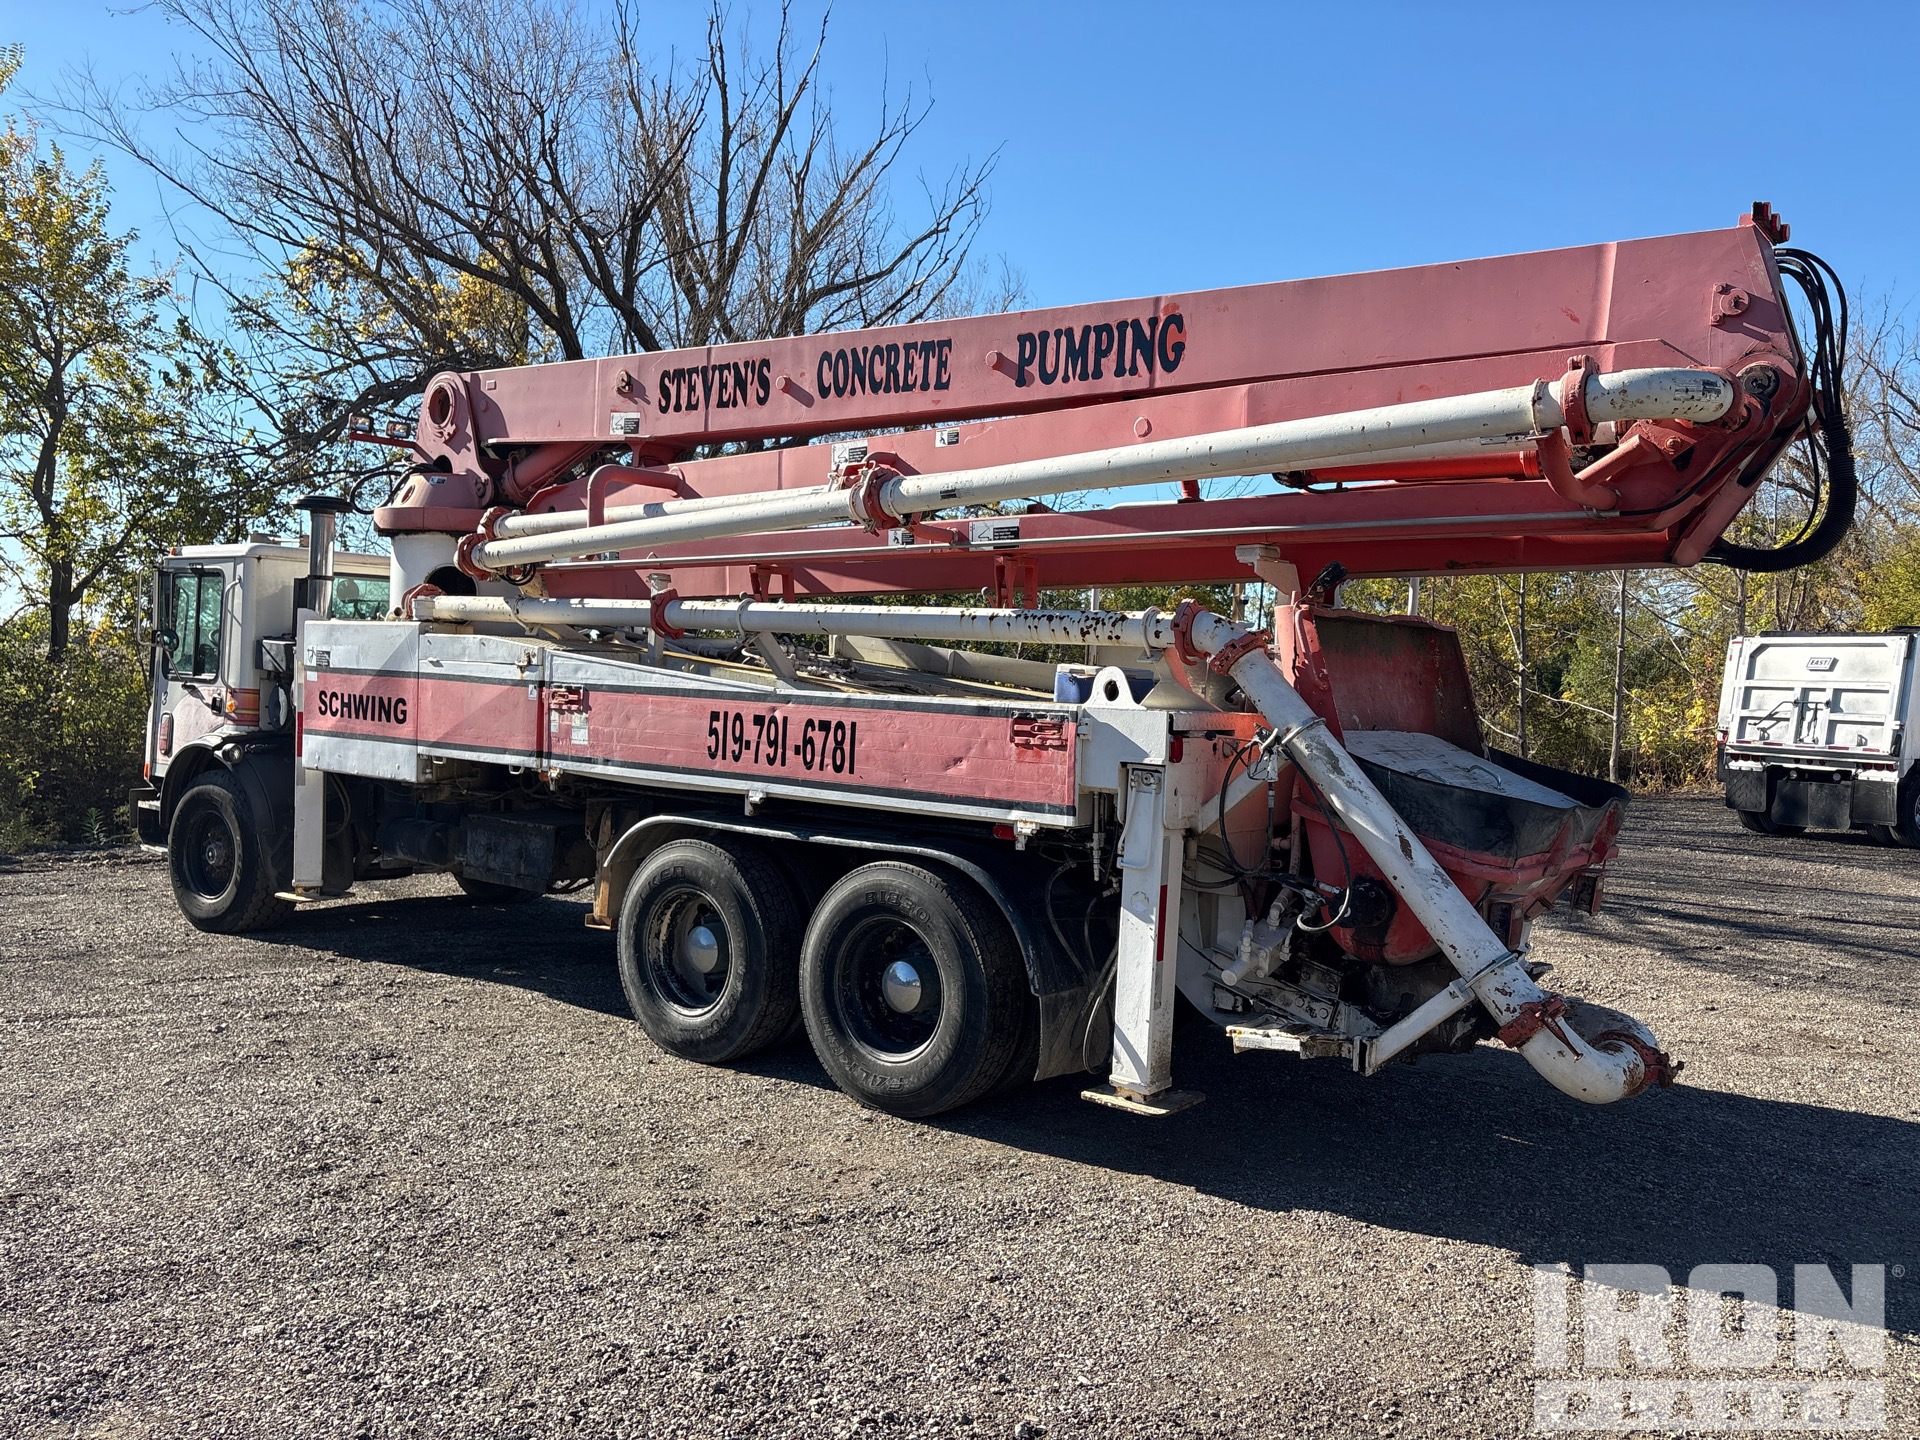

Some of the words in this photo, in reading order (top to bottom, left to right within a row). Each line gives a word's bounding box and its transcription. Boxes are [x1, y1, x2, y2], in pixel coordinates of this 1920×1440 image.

[658, 357, 771, 414] STEVEN'S
[816, 338, 953, 400] CONCRETE
[1015, 313, 1186, 388] PUMPING
[318, 689, 408, 725] SCHWING
[707, 710, 857, 775] 519-791-6781
